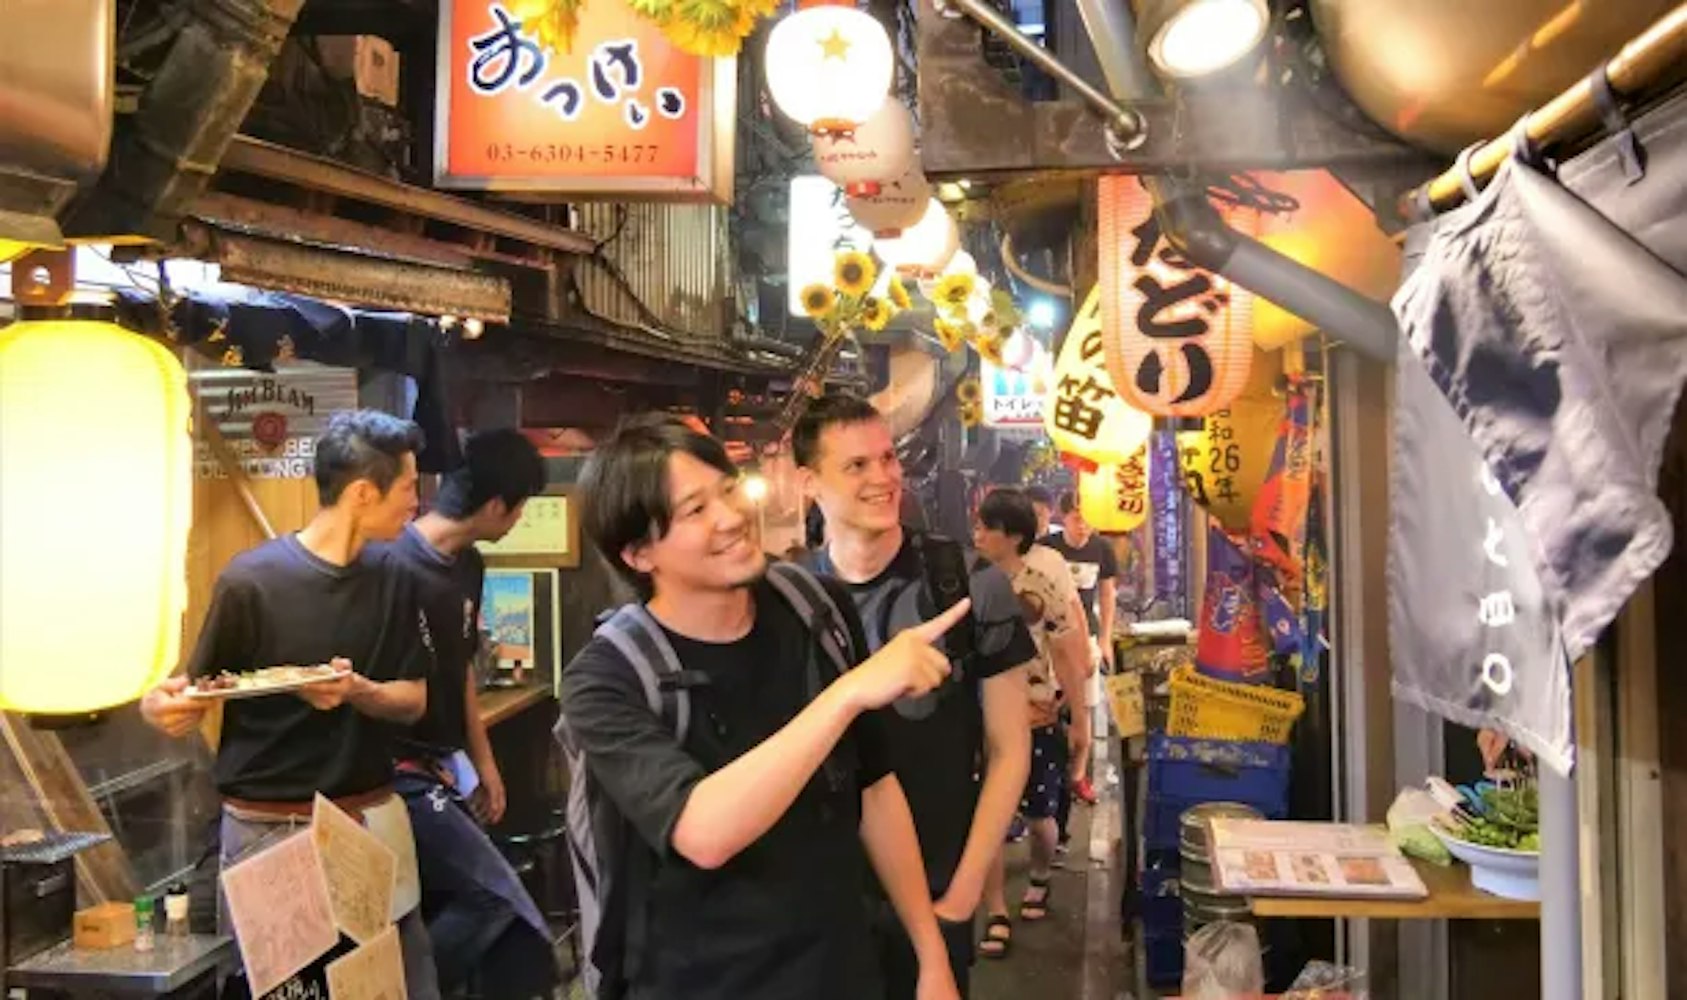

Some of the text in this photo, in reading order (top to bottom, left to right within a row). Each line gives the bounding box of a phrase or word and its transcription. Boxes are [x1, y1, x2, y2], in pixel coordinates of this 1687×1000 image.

[471, 7, 683, 124] おっけい
[486, 144, 660, 163] 03-6304-5477
[993, 397, 1044, 410] トイレ
